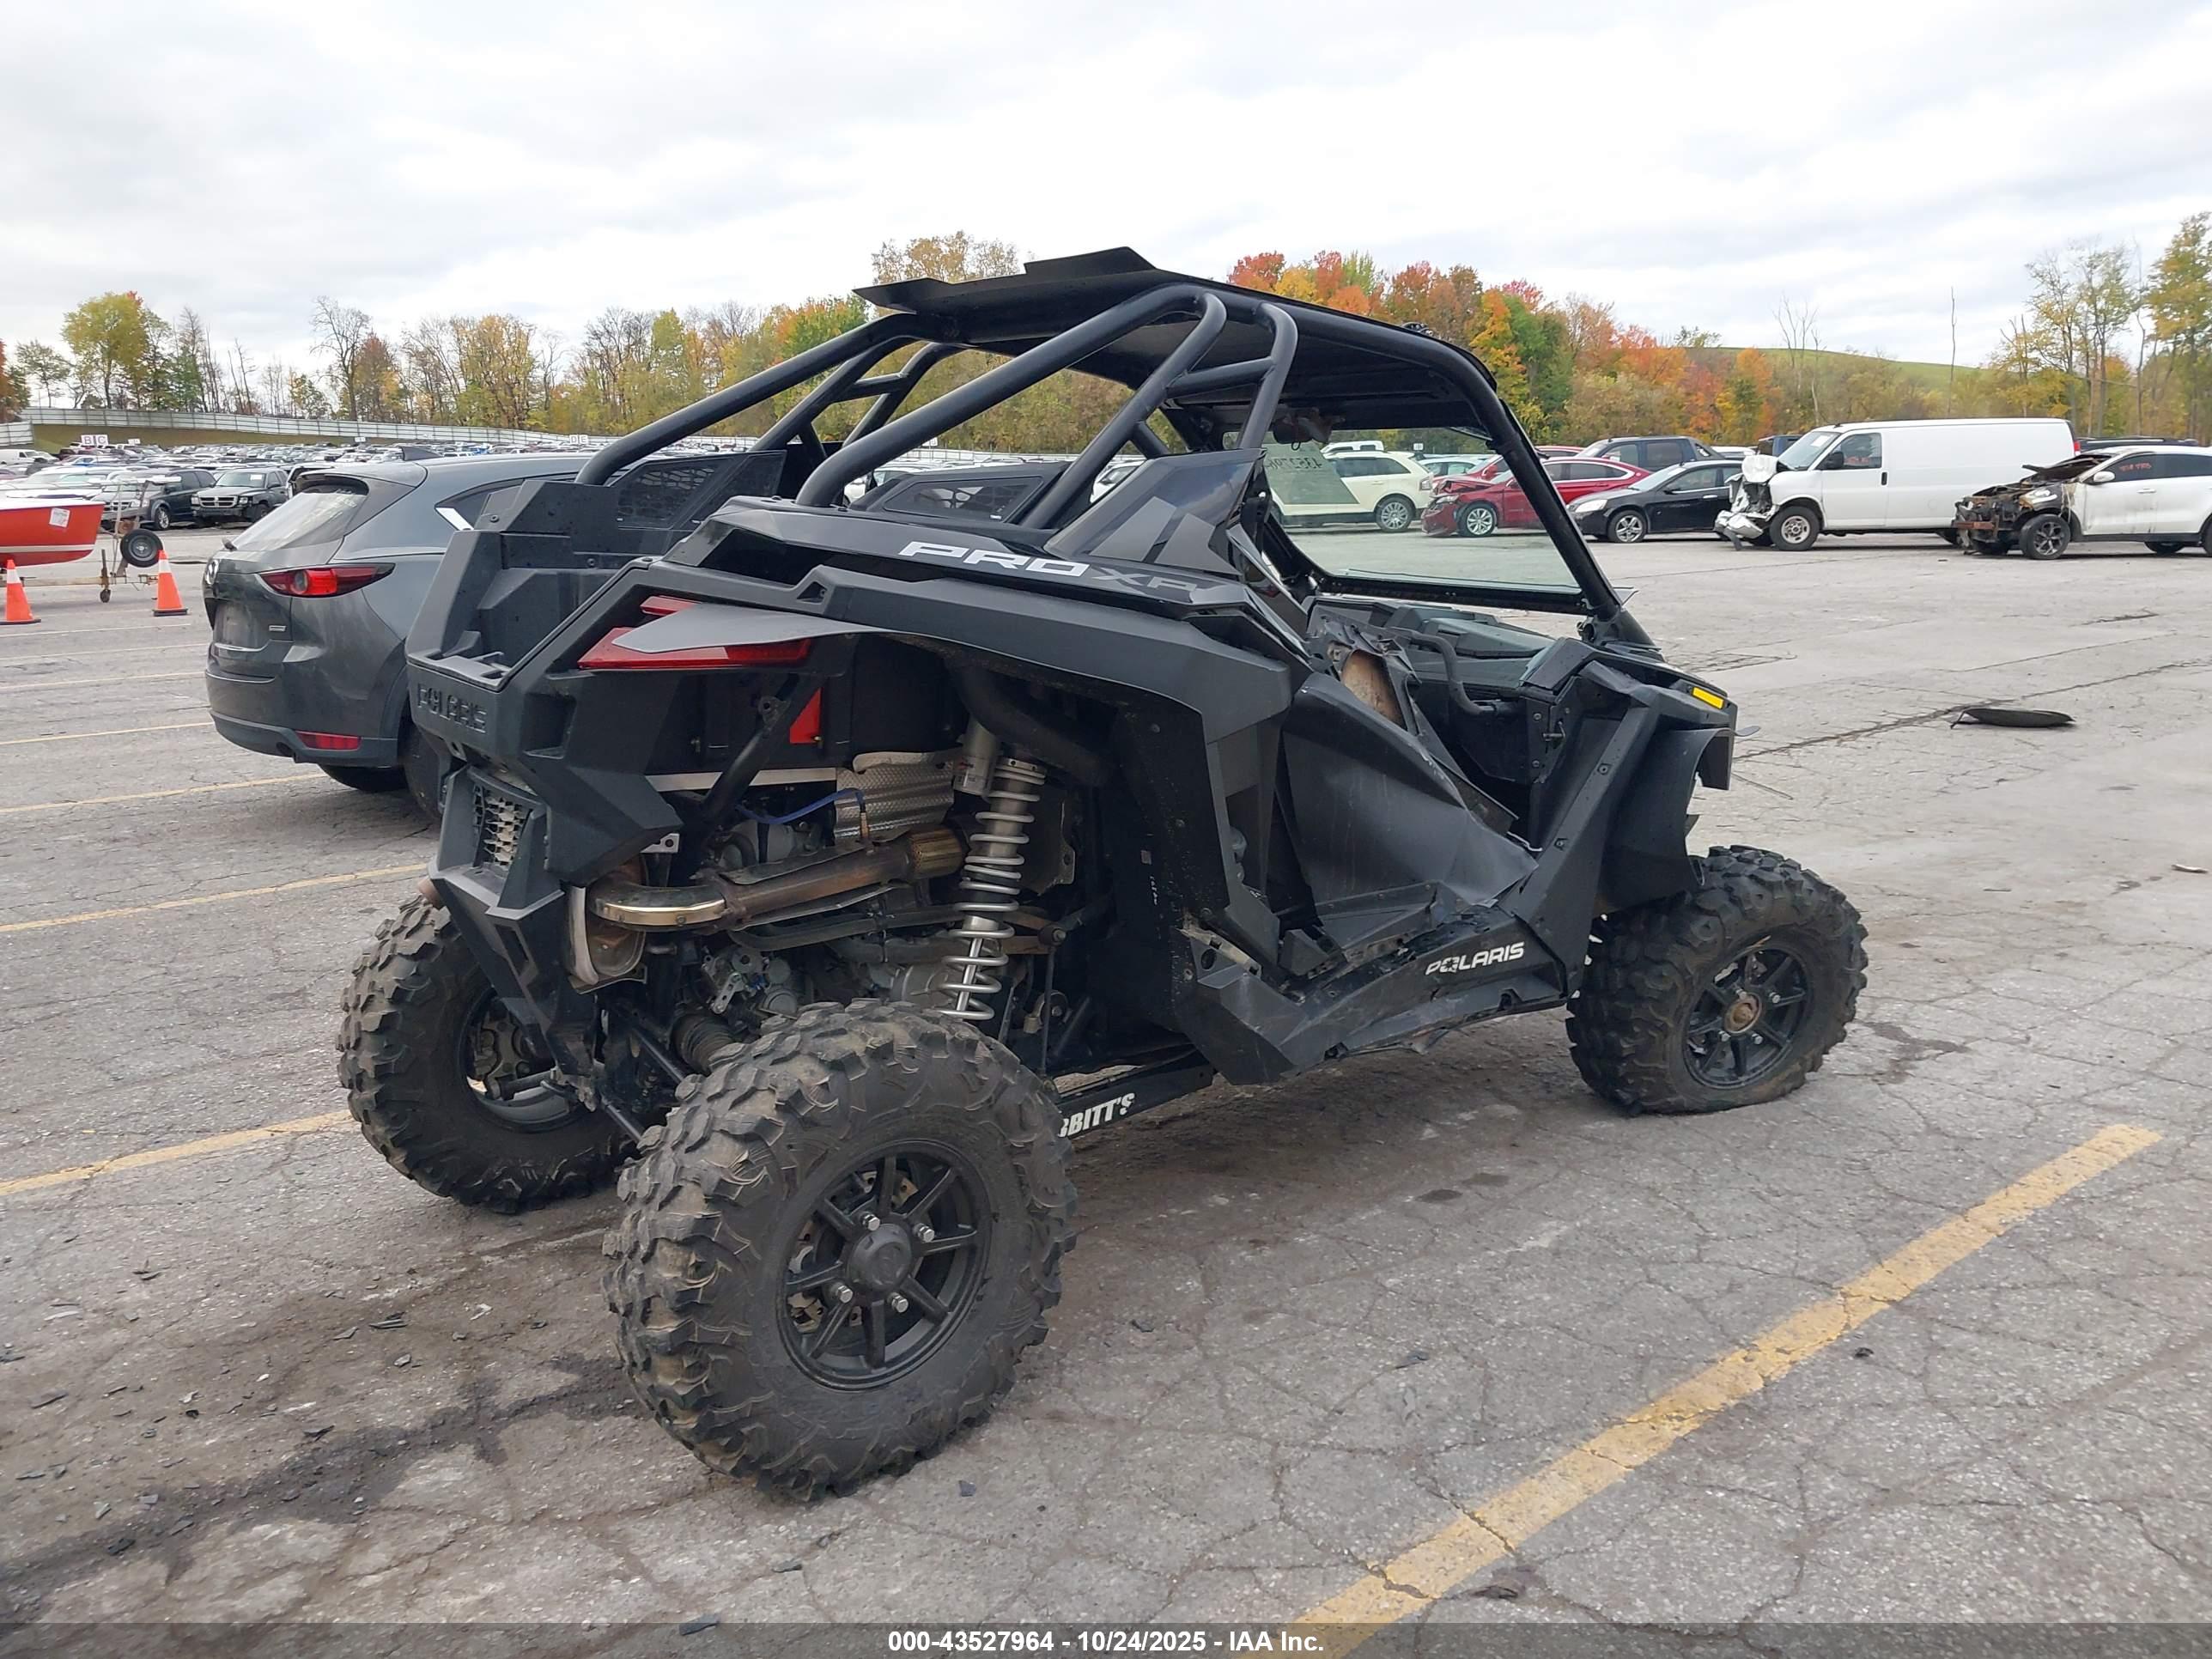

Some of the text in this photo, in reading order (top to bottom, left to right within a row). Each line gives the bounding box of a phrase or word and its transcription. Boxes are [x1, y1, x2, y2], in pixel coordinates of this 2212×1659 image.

[83, 435, 106, 445] B C
[898, 541, 1090, 576] PRO
[417, 684, 487, 733] POLARIS
[1425, 941, 1525, 975] POLARIS
